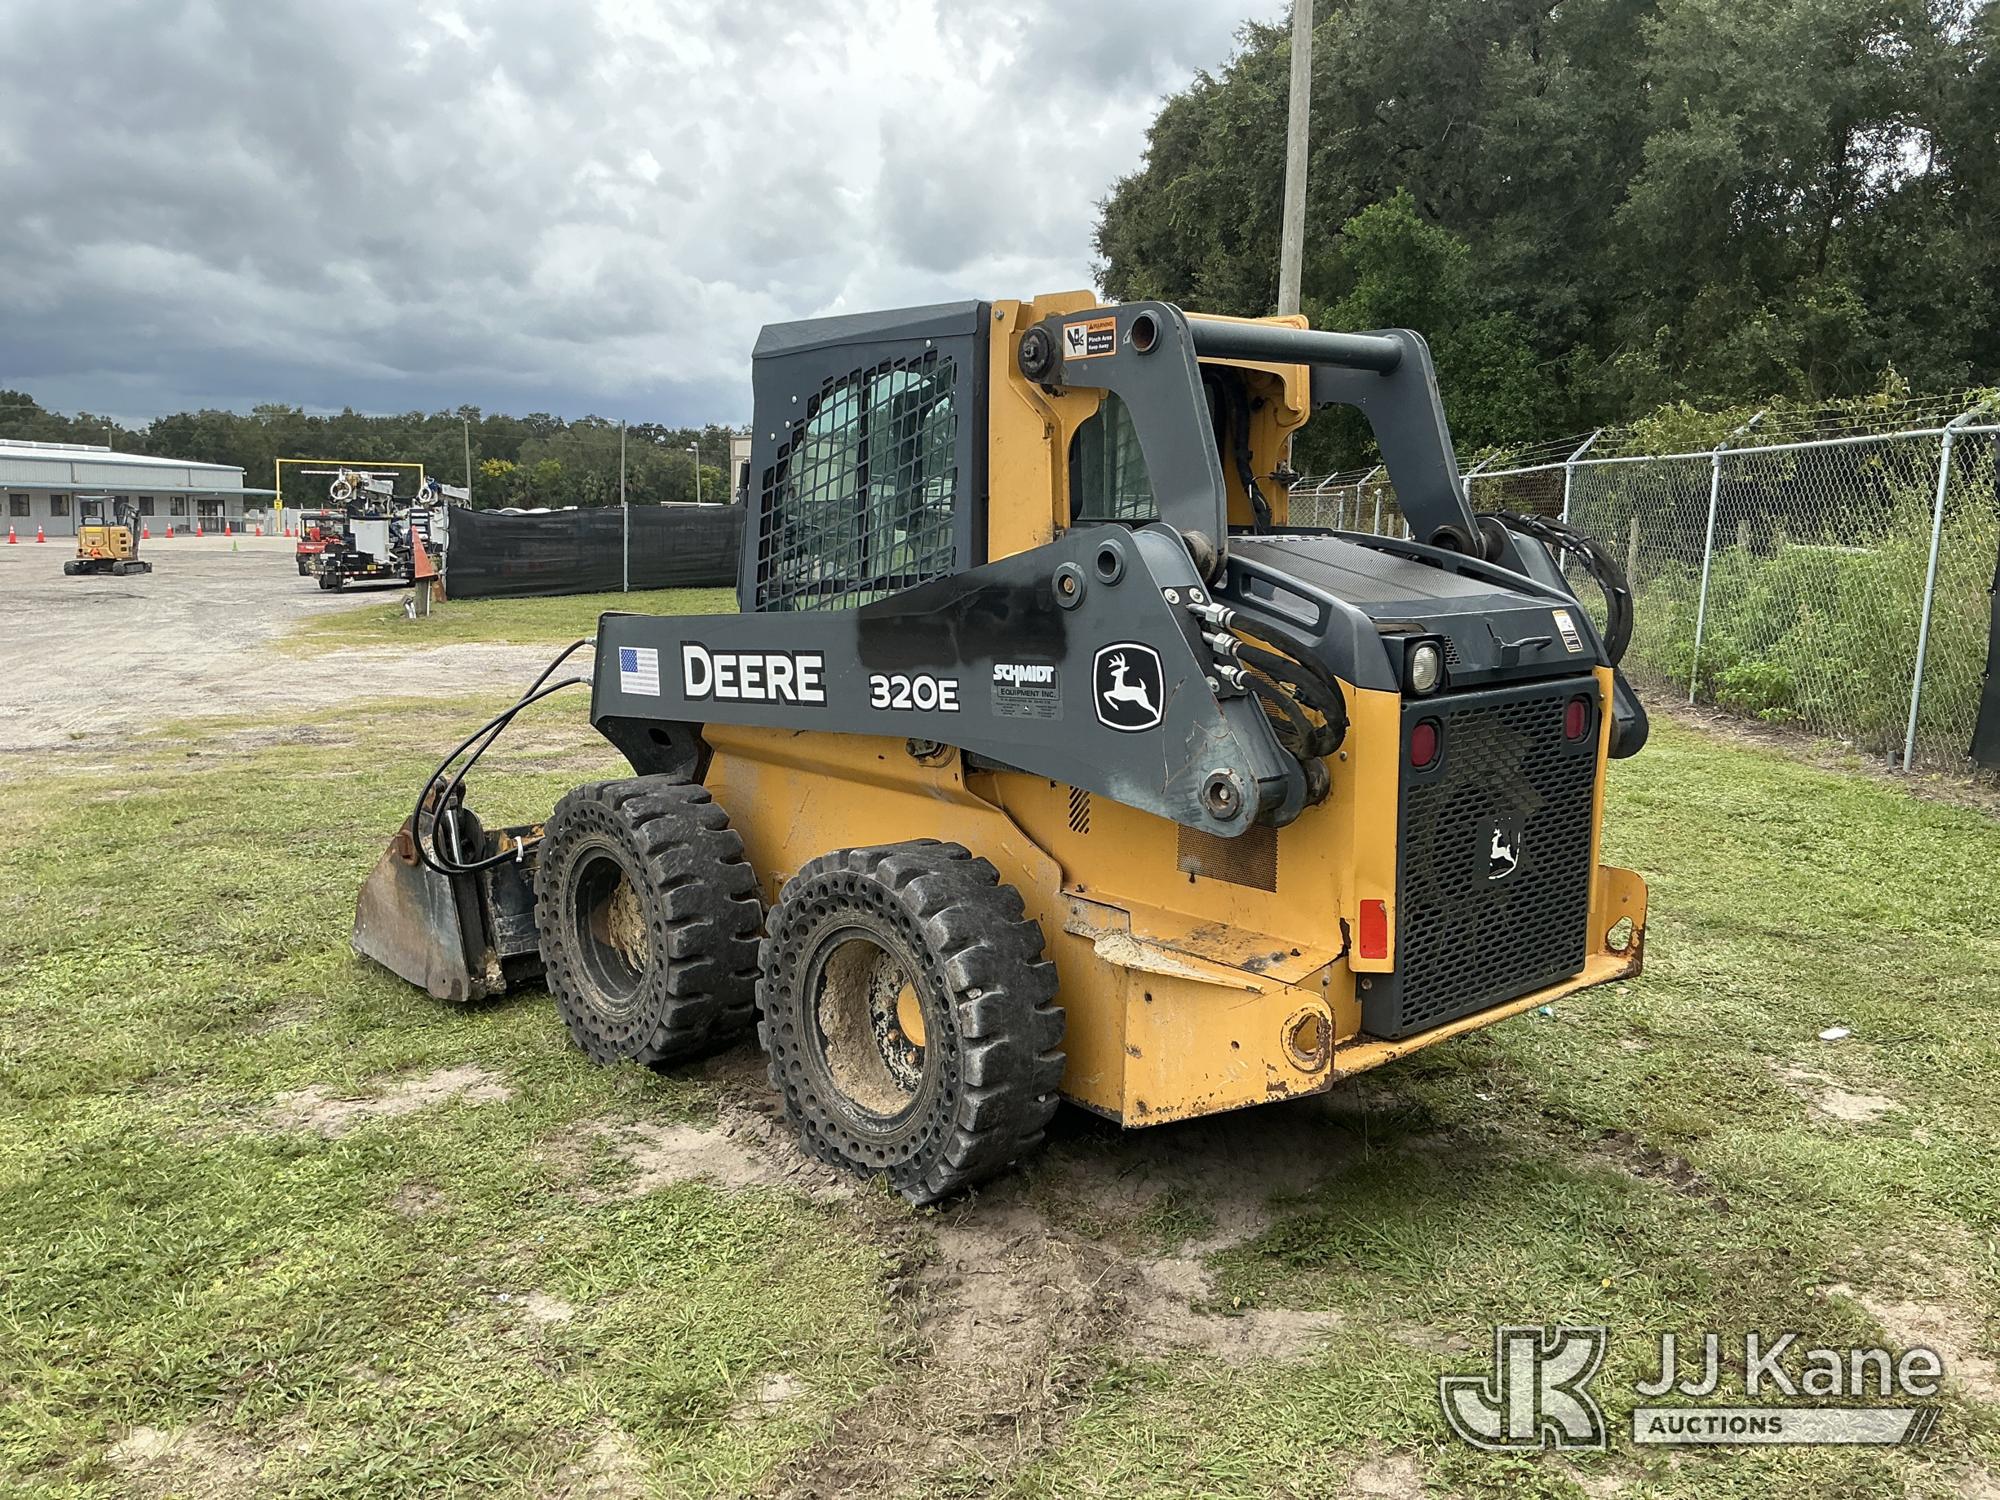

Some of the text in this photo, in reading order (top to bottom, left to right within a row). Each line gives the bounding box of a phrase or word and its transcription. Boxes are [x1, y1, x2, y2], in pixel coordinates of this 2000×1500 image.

[683, 644, 825, 702] DEERE
[993, 664, 1054, 687] SCHMIDT
[869, 675, 959, 711] 320E
[1000, 688, 1040, 696] EQUIPMENT
